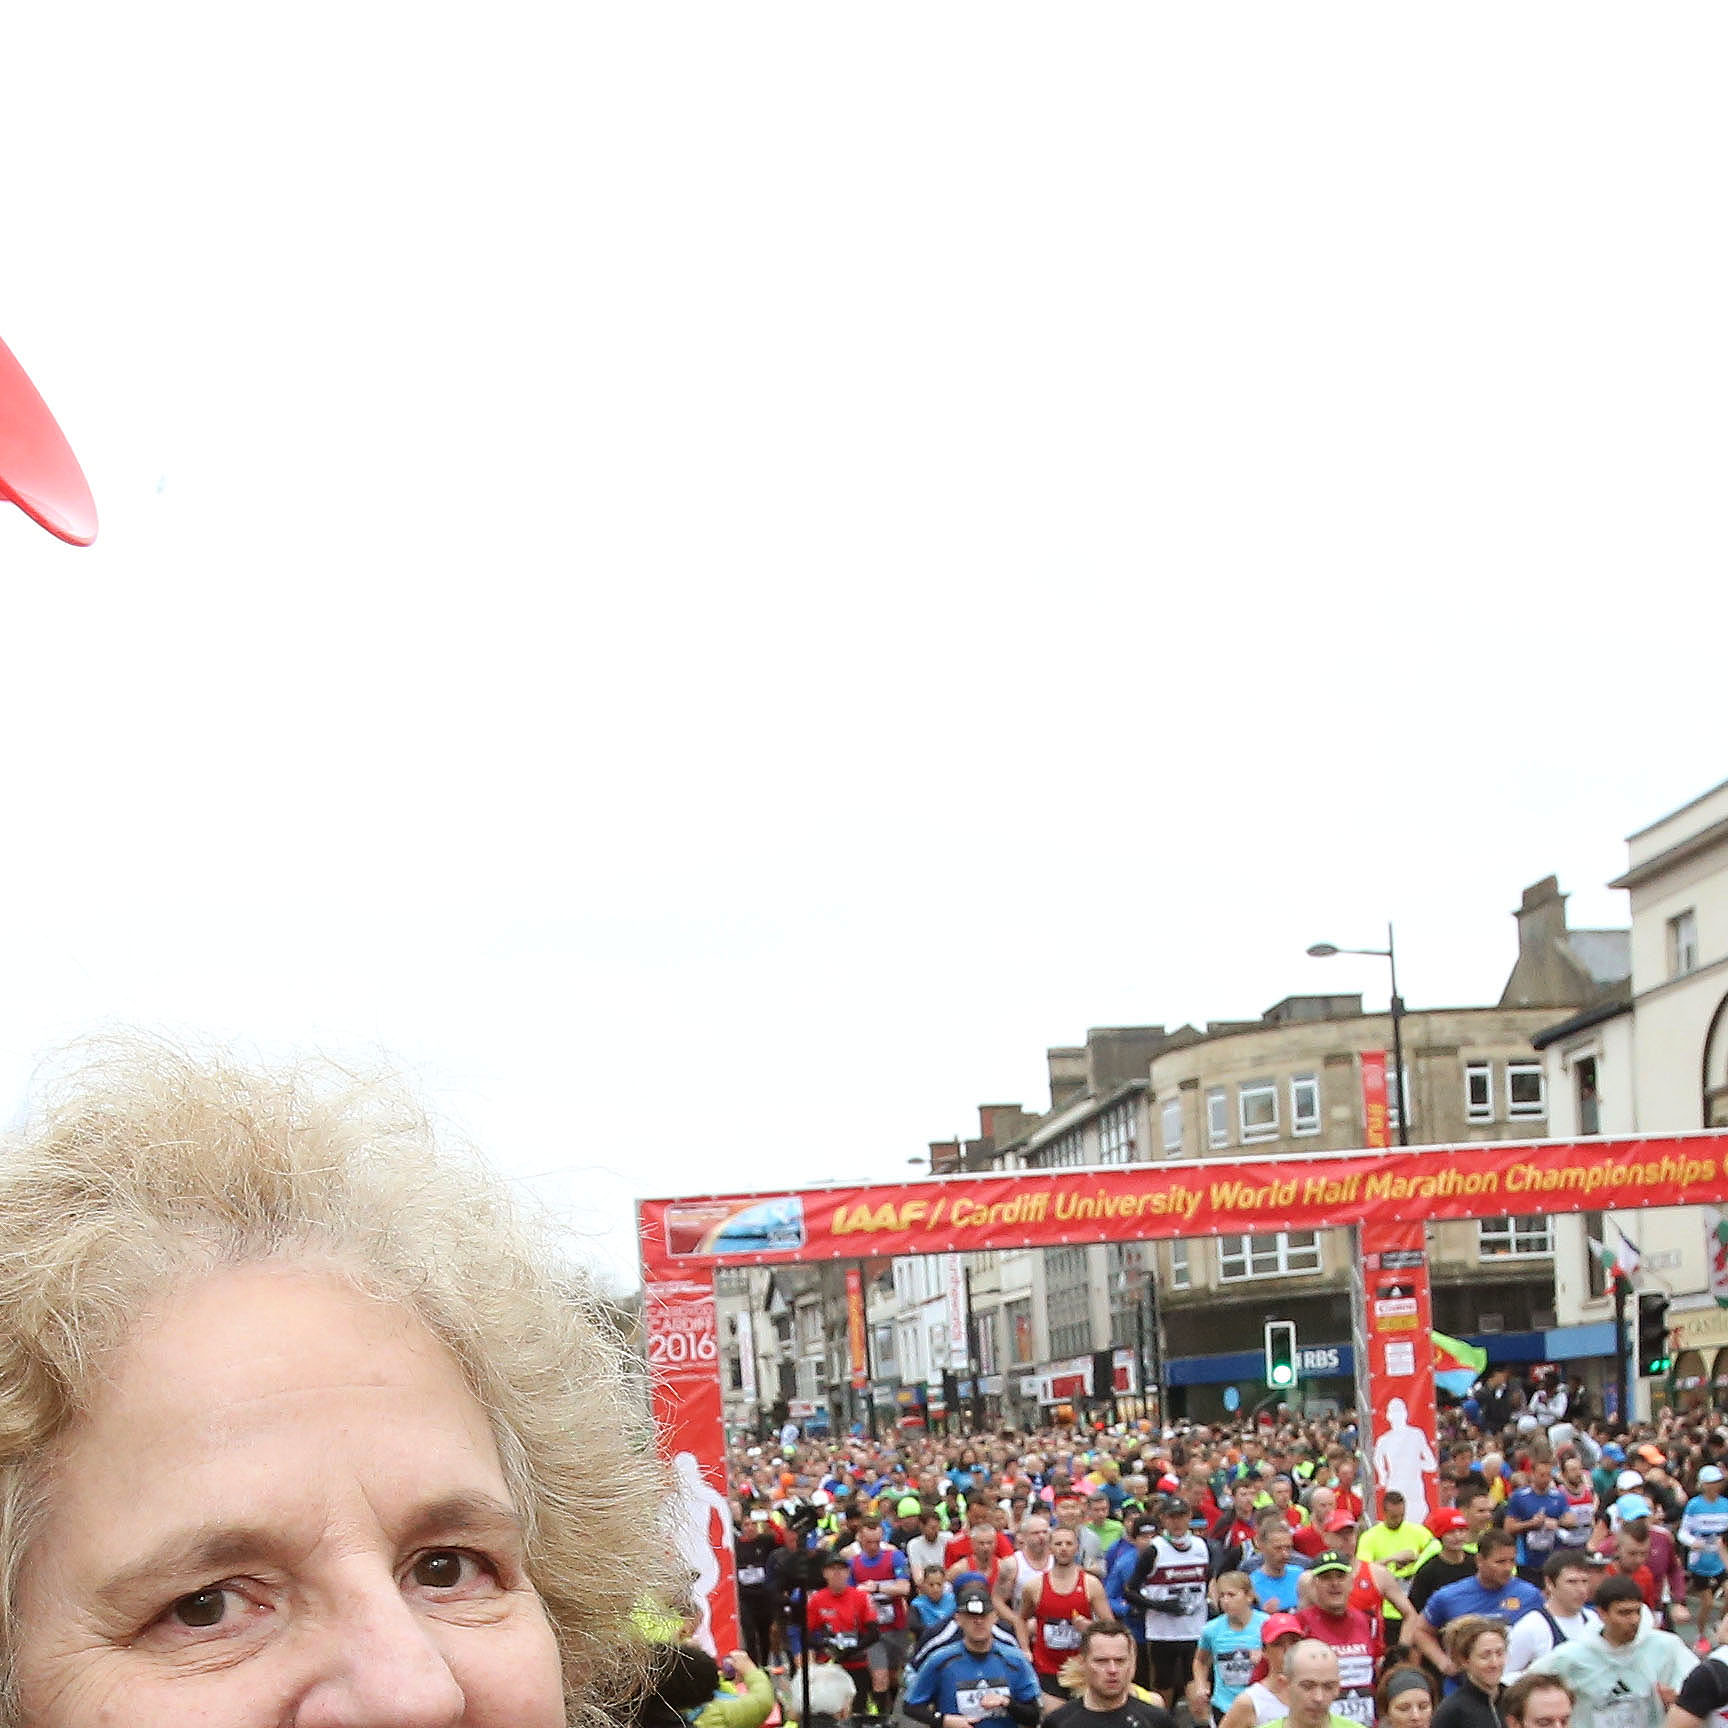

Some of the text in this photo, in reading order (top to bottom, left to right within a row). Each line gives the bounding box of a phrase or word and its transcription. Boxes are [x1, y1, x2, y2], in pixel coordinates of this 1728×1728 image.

[831, 1201, 928, 1234] IAAF
[950, 1193, 1051, 1228] Cardiff
[1055, 1185, 1203, 1221] University
[1210, 1178, 1297, 1210] World
[1304, 1173, 1363, 1205] Half
[1365, 1168, 1498, 1199] Marathon
[1505, 1153, 1716, 1193] Championships
[648, 1332, 718, 1362] 2016
[1304, 1349, 1340, 1371] RBS
